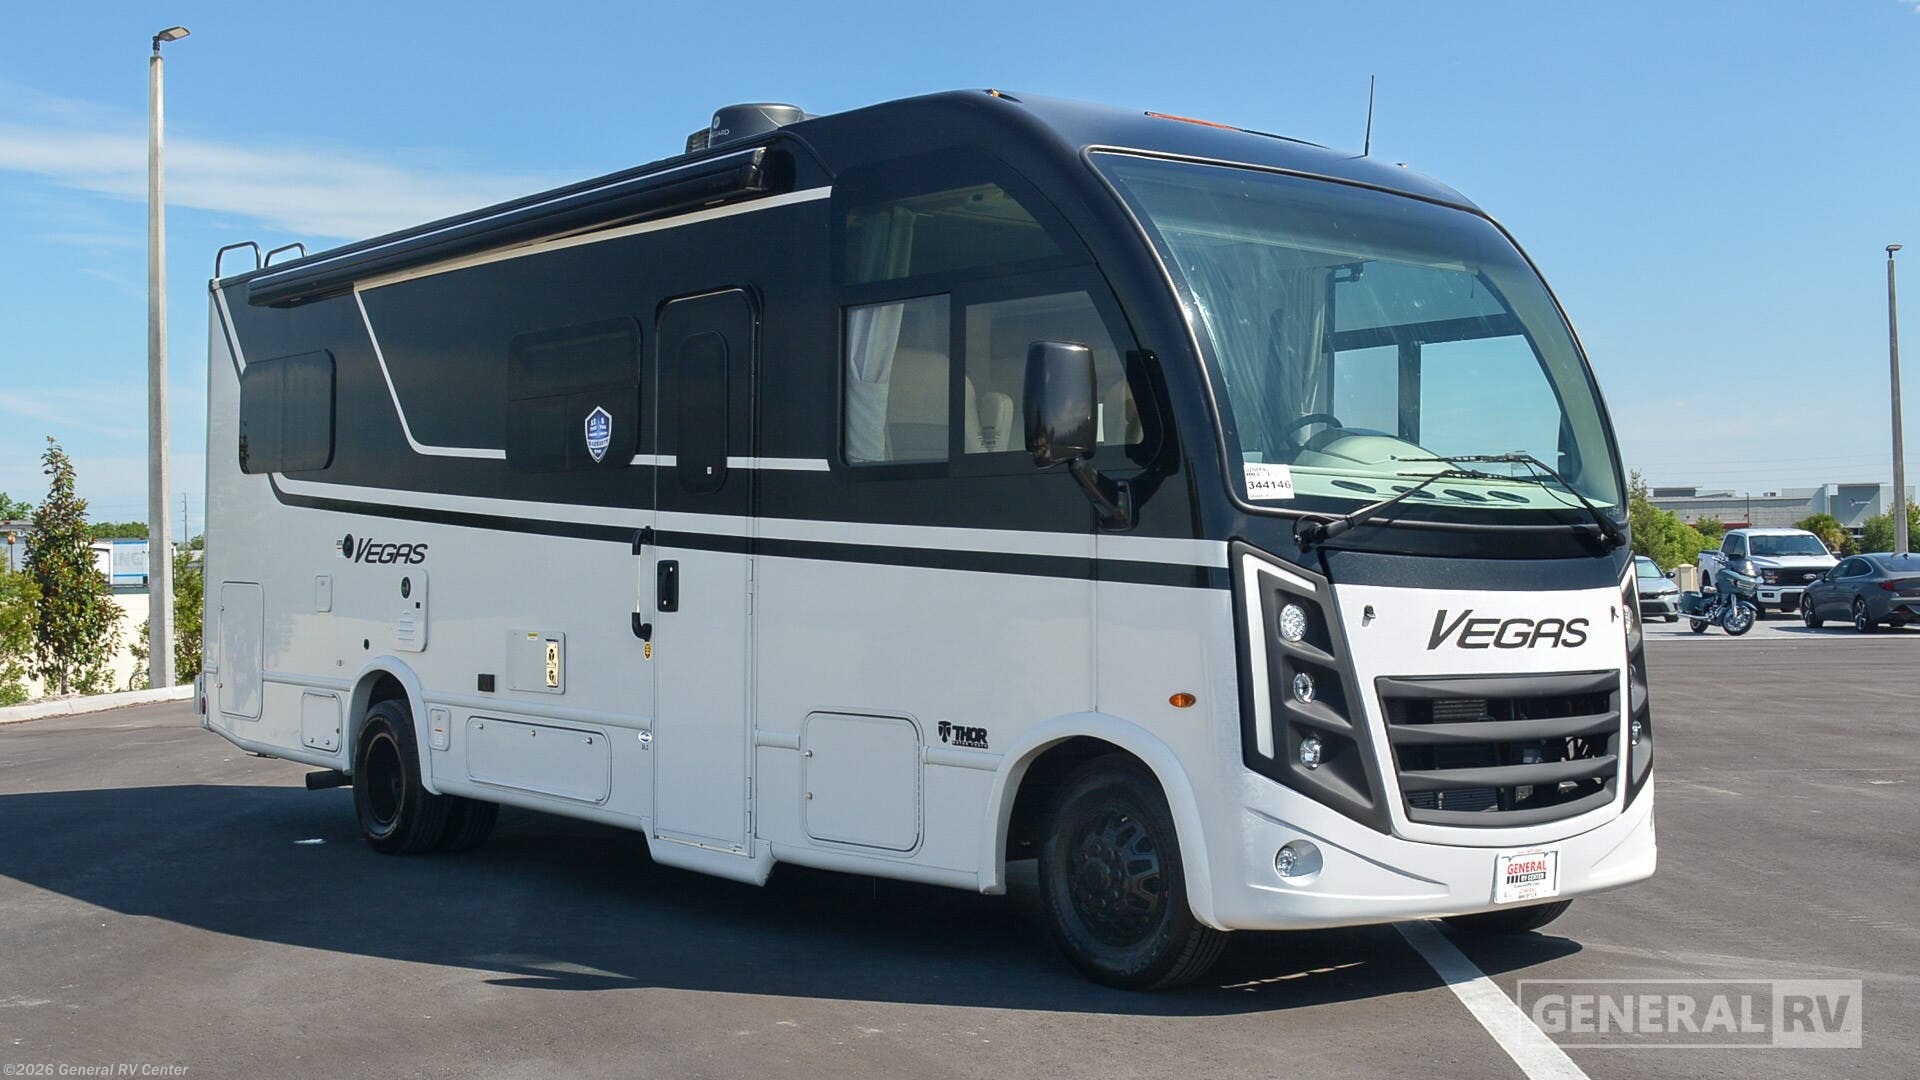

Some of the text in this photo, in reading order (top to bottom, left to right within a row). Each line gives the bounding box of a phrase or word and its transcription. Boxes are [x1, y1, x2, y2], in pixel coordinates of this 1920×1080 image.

[1248, 480, 1292, 490] 344146
[354, 538, 428, 564] VEGAS
[1427, 609, 1590, 650] VEGAS
[952, 725, 987, 744] THOR
[1507, 860, 1547, 875] GENERAL
